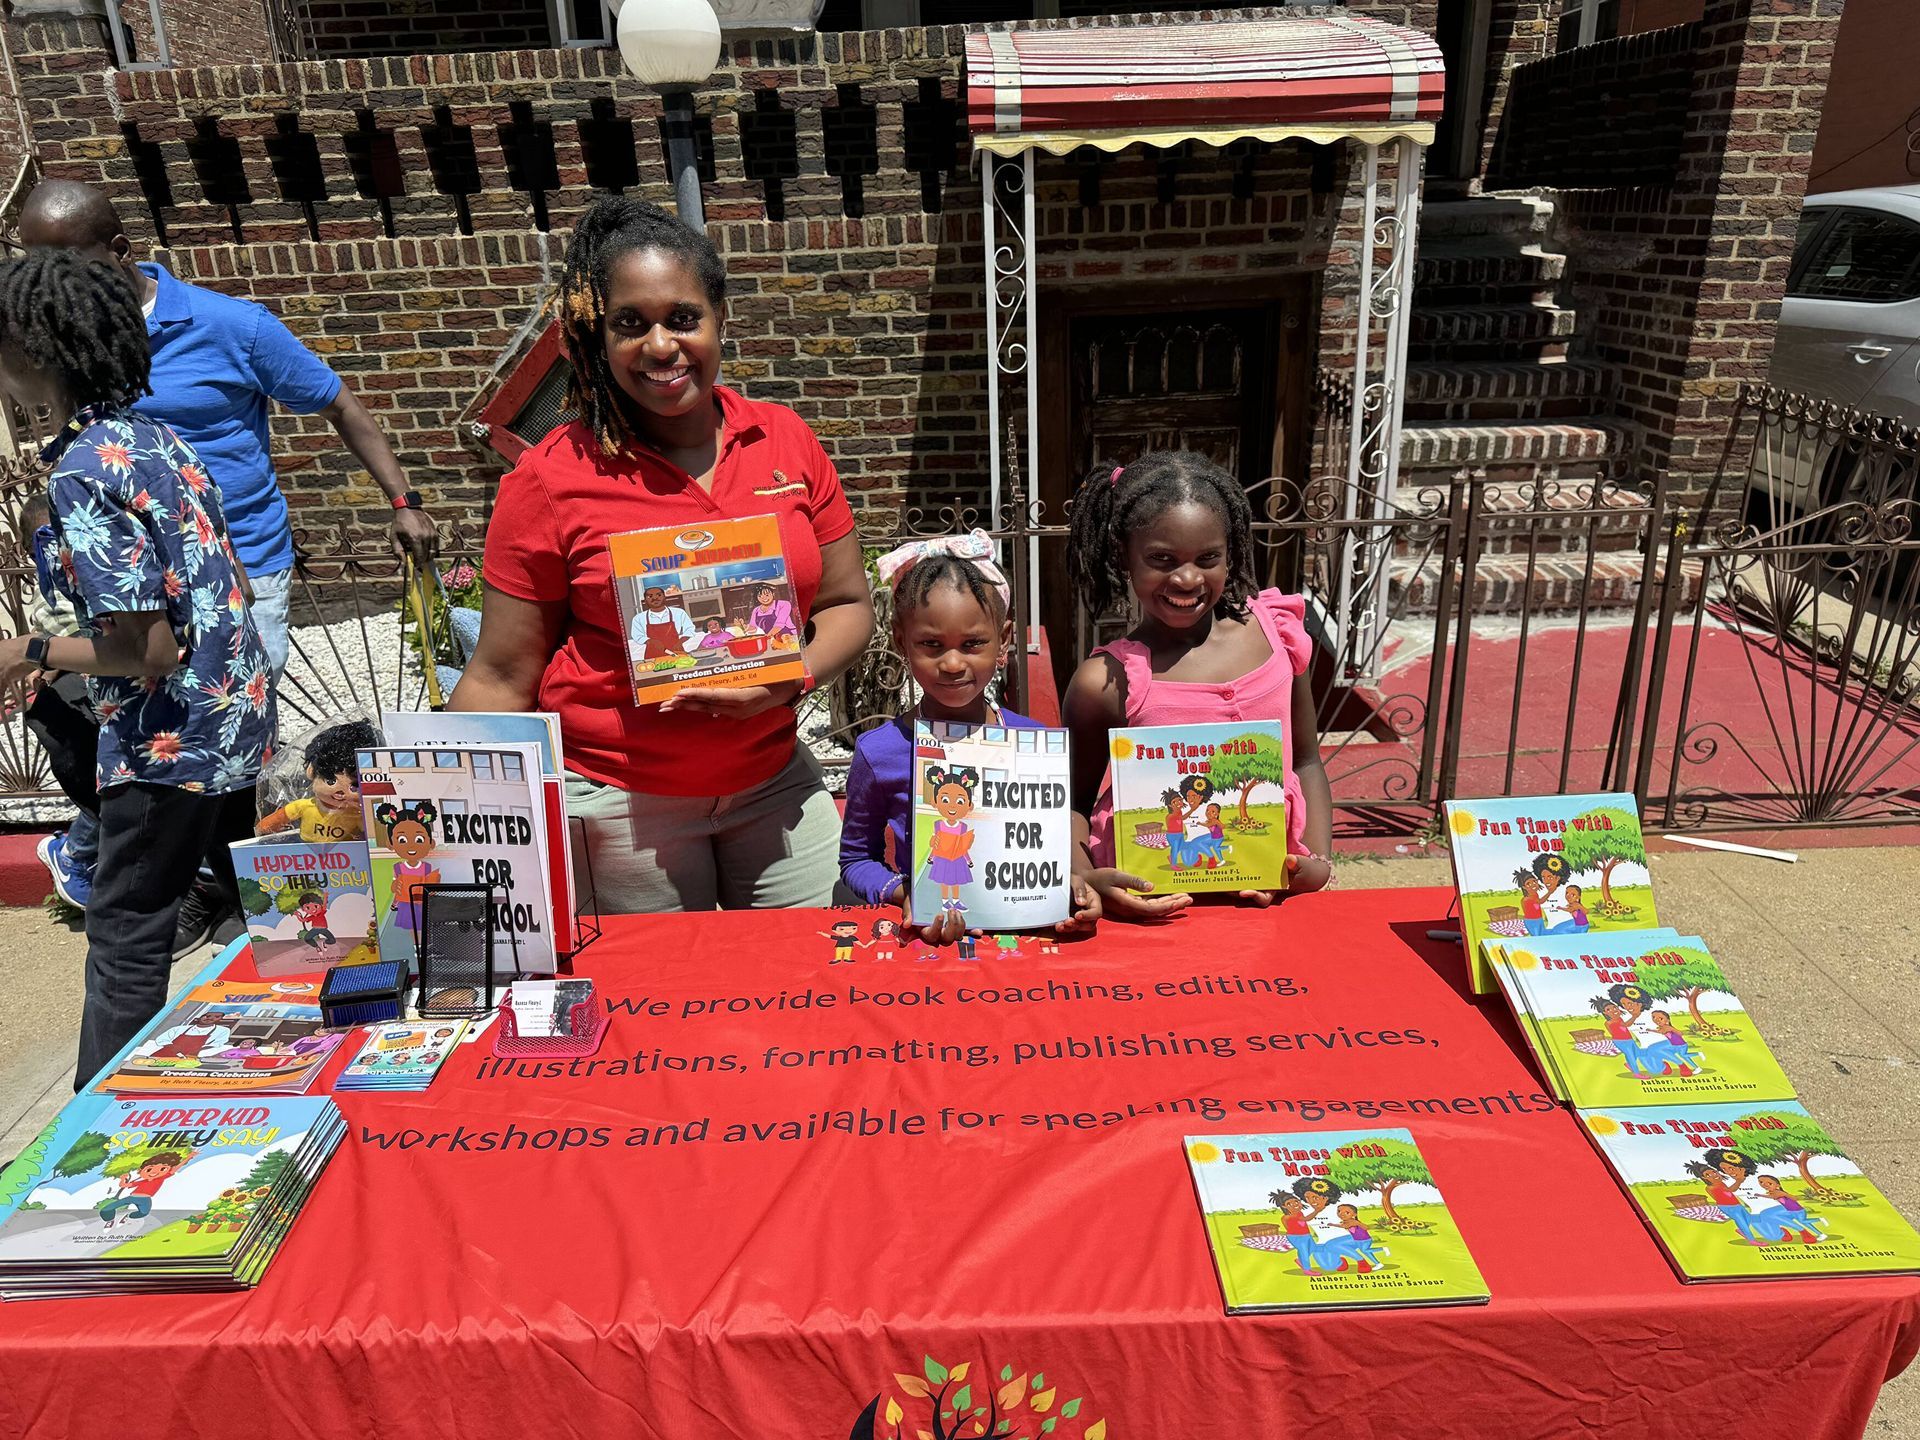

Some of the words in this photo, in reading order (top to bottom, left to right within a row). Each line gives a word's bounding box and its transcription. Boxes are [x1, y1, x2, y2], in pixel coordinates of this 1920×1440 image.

[641, 554, 685, 573] SOUP
[672, 669, 712, 681] Freedom
[713, 661, 765, 674] Celebration
[1136, 744, 1165, 760] Fun
[1170, 742, 1215, 758] Times
[1220, 739, 1257, 756] with
[1177, 759, 1211, 775] Mom
[982, 780, 1066, 809] EXCITED
[313, 823, 345, 838] RIO
[441, 814, 532, 845] EXCITED
[1478, 818, 1511, 836] Fun
[1516, 817, 1567, 833] Times
[1572, 814, 1613, 831] with
[1004, 822, 1043, 850] FOR
[1526, 836, 1565, 852] Mom
[253, 854, 317, 873] HYPER
[318, 852, 355, 871] KID,
[258, 876, 284, 893] SO
[283, 873, 328, 890] THEY
[329, 871, 369, 888] SAY!
[472, 858, 514, 890] FOR
[984, 860, 1063, 891] SCHOOL
[1540, 955, 1578, 970] Fun
[1580, 954, 1636, 969] Times
[1641, 951, 1686, 966] with
[1595, 969, 1640, 983] Mom
[606, 997, 671, 1016] We
[682, 989, 837, 1019] provide
[849, 986, 945, 1006] book
[956, 980, 1145, 1003] coaching,
[1154, 975, 1309, 997] editing,
[475, 1048, 748, 1080] illustrations,
[762, 1039, 1000, 1069] formatting,
[1013, 1032, 1236, 1065] publishing
[1246, 1026, 1440, 1052] services,
[120, 1109, 218, 1128] HYPER
[217, 1107, 271, 1127] KID,
[362, 1124, 613, 1152] workshops
[624, 1118, 710, 1147] and
[723, 1107, 926, 1143] available
[938, 1107, 1005, 1131] for
[1019, 1097, 1226, 1131] speaking
[1620, 1121, 1664, 1136] Fun
[1667, 1119, 1732, 1134] Times
[1736, 1116, 1788, 1131] with
[103, 1131, 149, 1150] SO
[147, 1130, 218, 1148] THEY
[212, 1127, 280, 1147] SAY!
[1687, 1133, 1737, 1148] Mom
[1224, 1149, 1264, 1163] Fun
[1269, 1146, 1330, 1162] Times
[1337, 1143, 1388, 1159] with
[1283, 1162, 1331, 1177] Mom
[1310, 1283, 1369, 1291] Illustrator:
[1372, 1281, 1403, 1289] Justin
[1407, 1279, 1445, 1287] Saviour
